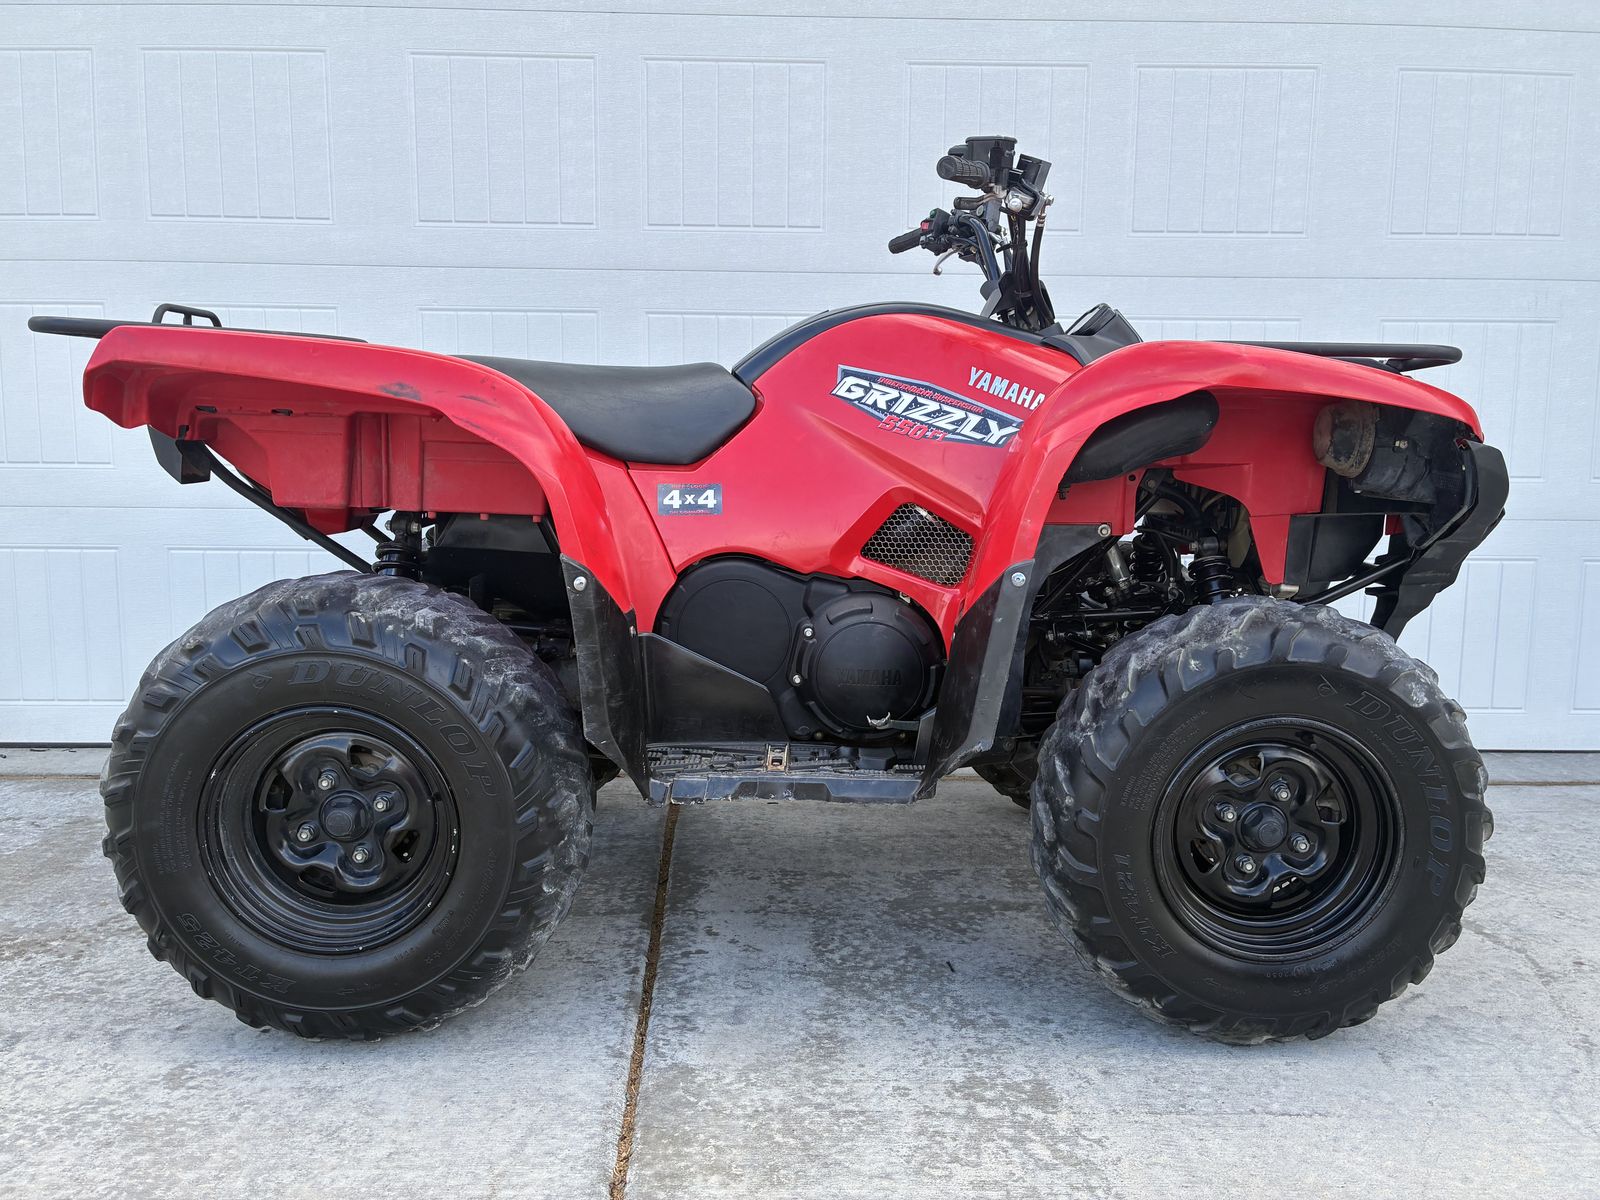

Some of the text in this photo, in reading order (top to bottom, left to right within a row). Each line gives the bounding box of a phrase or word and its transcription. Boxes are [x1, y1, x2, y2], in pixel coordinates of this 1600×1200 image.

[831, 375, 1022, 445] GRIZZLY
[967, 366, 1046, 411] YAMAHA
[662, 489, 718, 510] 4x4
[837, 667, 903, 687] YAMAHA
[288, 659, 498, 798] DUNLOP
[1343, 690, 1454, 898] DUNLOP
